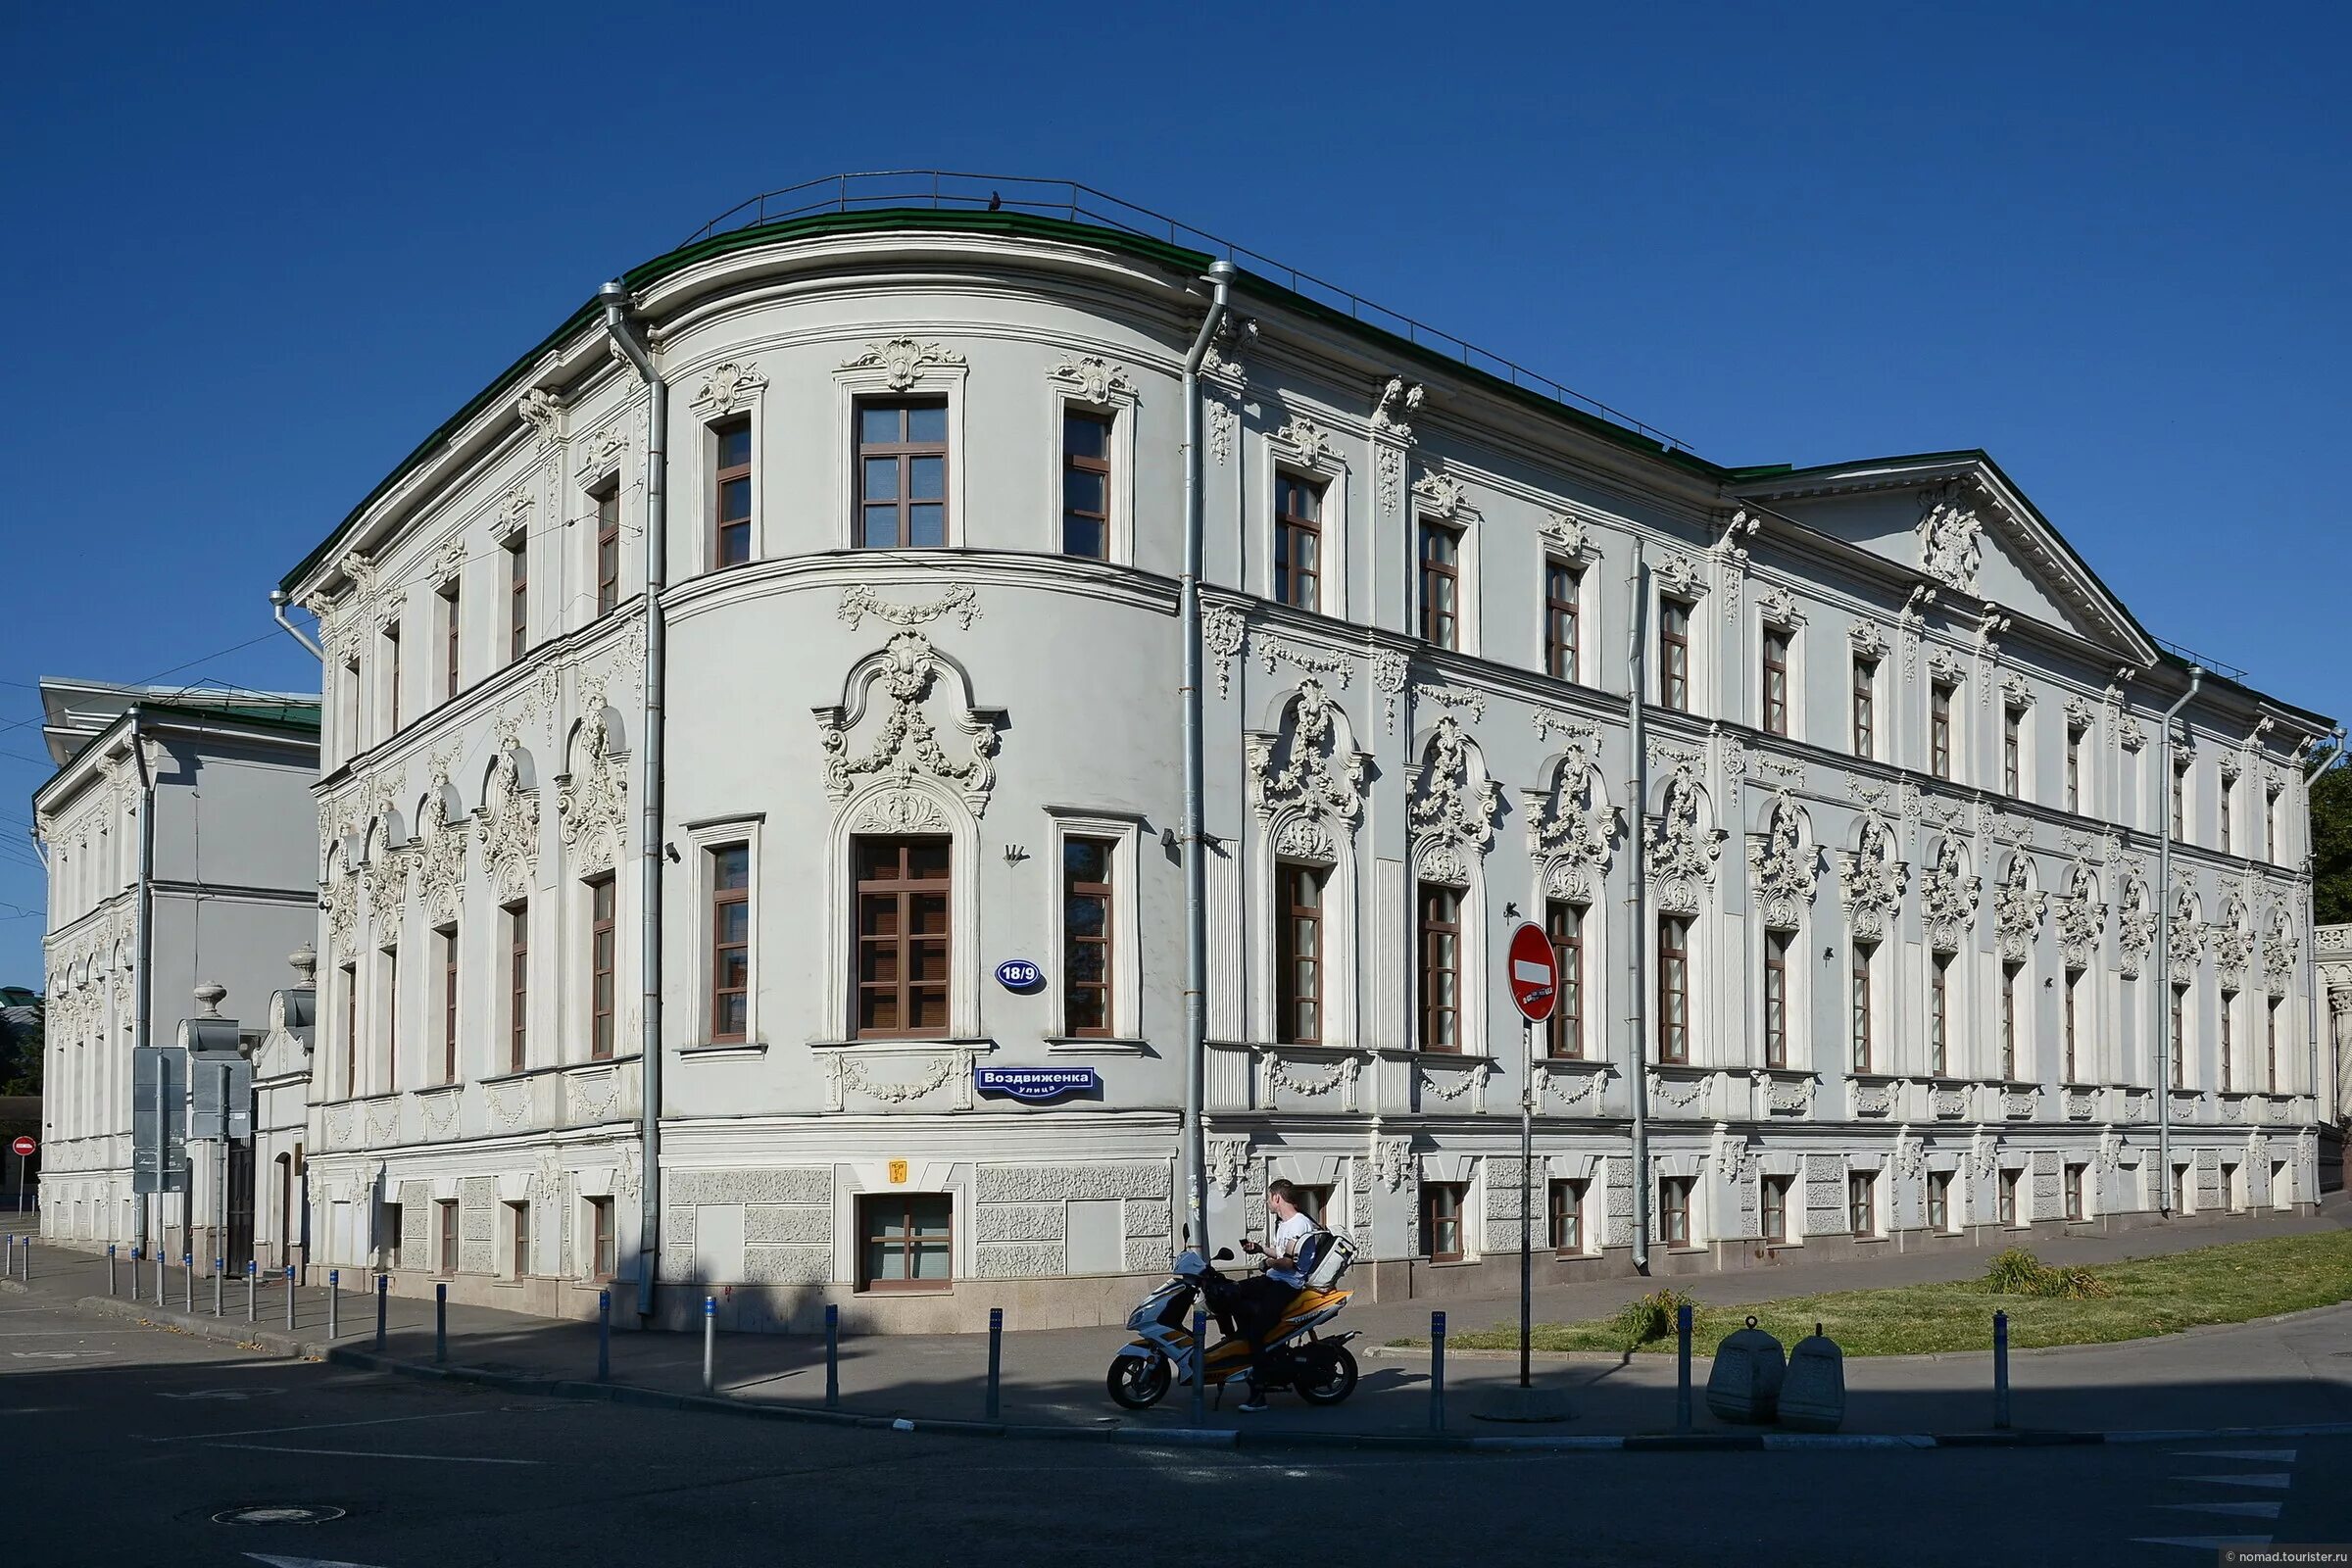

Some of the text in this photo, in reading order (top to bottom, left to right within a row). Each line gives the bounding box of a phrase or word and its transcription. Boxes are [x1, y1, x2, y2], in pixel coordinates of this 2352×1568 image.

[1003, 966, 1035, 980] 18/9
[984, 1072, 1089, 1084] Воздвиженка
[1018, 1085, 1055, 1094] улица
